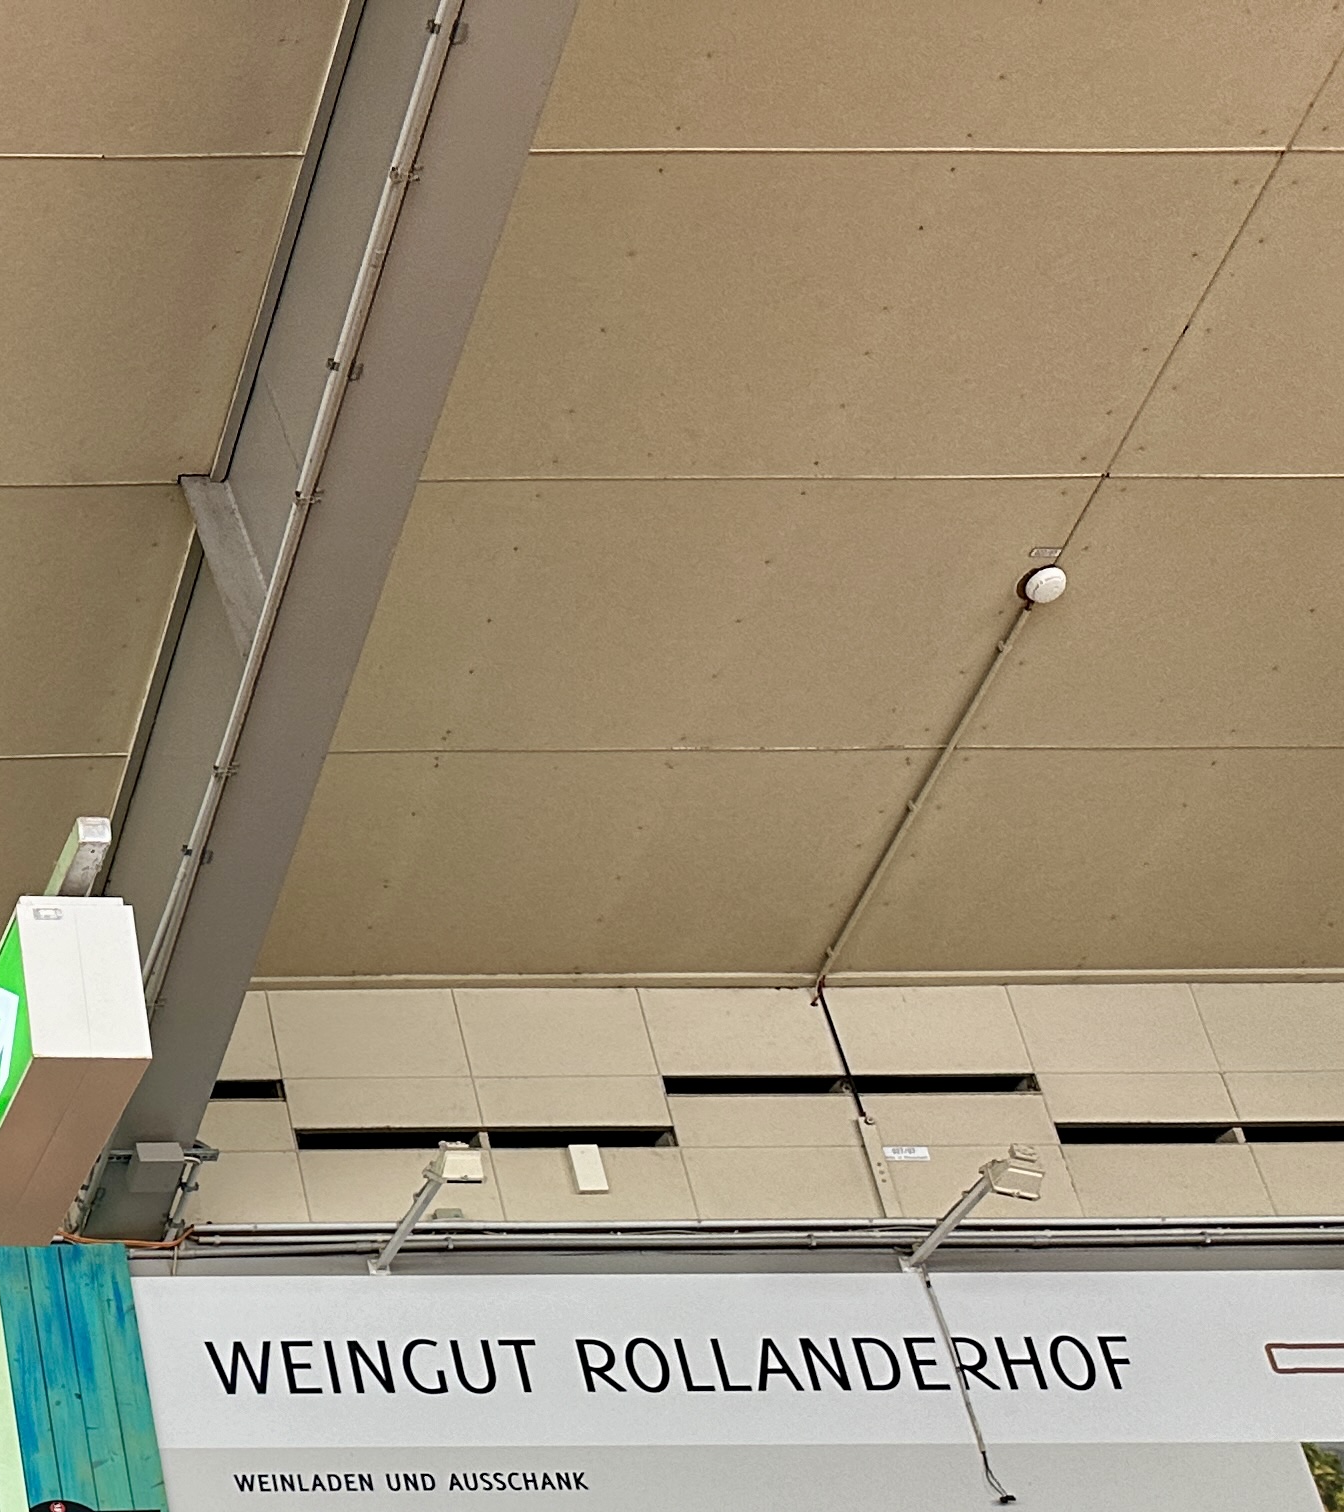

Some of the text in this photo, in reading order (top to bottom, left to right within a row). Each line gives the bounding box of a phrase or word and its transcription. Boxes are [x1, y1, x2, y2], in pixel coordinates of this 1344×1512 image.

[203, 1334, 1132, 1396] WEINGUT ROLLANDERHOF
[233, 1471, 590, 1493] WEINLADEN UND AUSSCHANK
